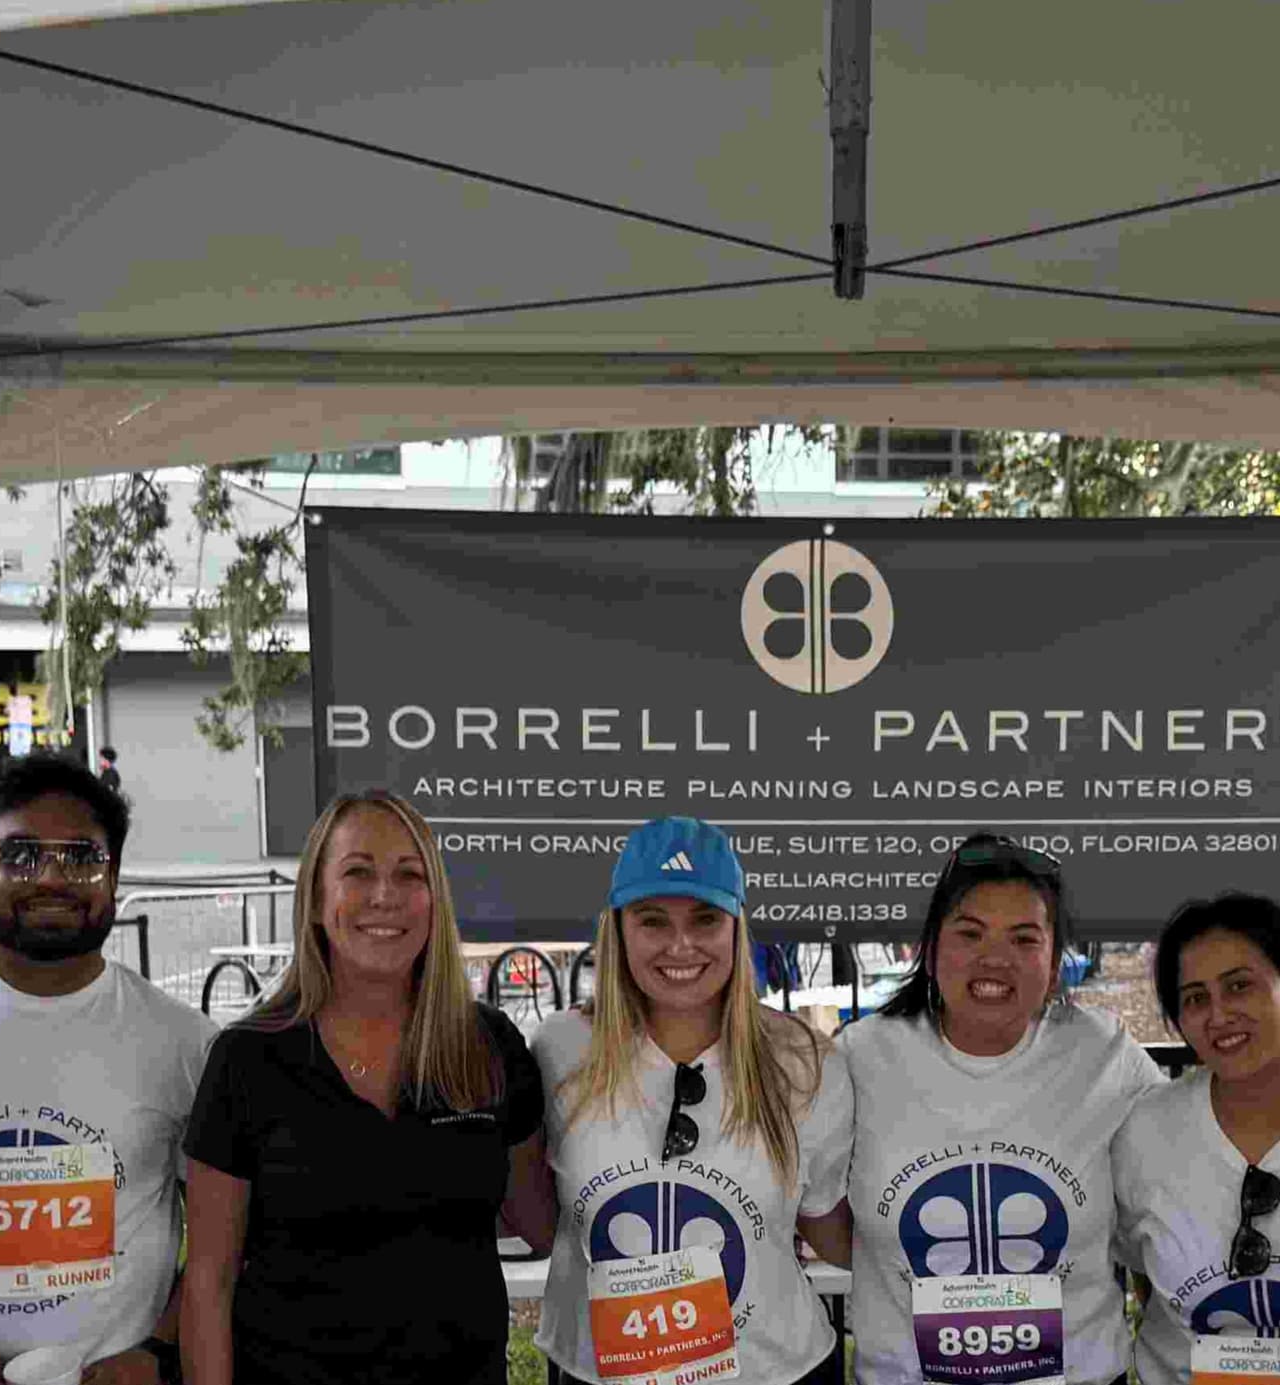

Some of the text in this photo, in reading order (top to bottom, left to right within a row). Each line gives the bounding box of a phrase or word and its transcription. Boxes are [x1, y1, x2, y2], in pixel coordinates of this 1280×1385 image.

[326, 704, 758, 752] BORRELLI
[806, 725, 831, 752] +
[413, 777, 1254, 799] ARCHITECTURE PLANNING LANDSCAPE INTERIORS
[437, 833, 522, 853] ORTH
[533, 834, 628, 854] ORANG
[789, 836, 869, 854] SUITE
[876, 836, 923, 856] 120,
[1082, 834, 1198, 853] FLORIDA
[1205, 834, 1278, 853] 32801
[746, 872, 941, 888] RELLIARCHITEC
[751, 904, 908, 921] 407.418.1338
[37, 1105, 127, 1191] PARTRS
[877, 1141, 1088, 1219] BORRELLI + PARTNERS
[677, 1158, 767, 1242] PARTNERS
[46, 1266, 112, 1288] RUNNER
[621, 1299, 698, 1340] 419
[938, 1323, 1041, 1357] 8959
[599, 1350, 647, 1365] BORRELLI
